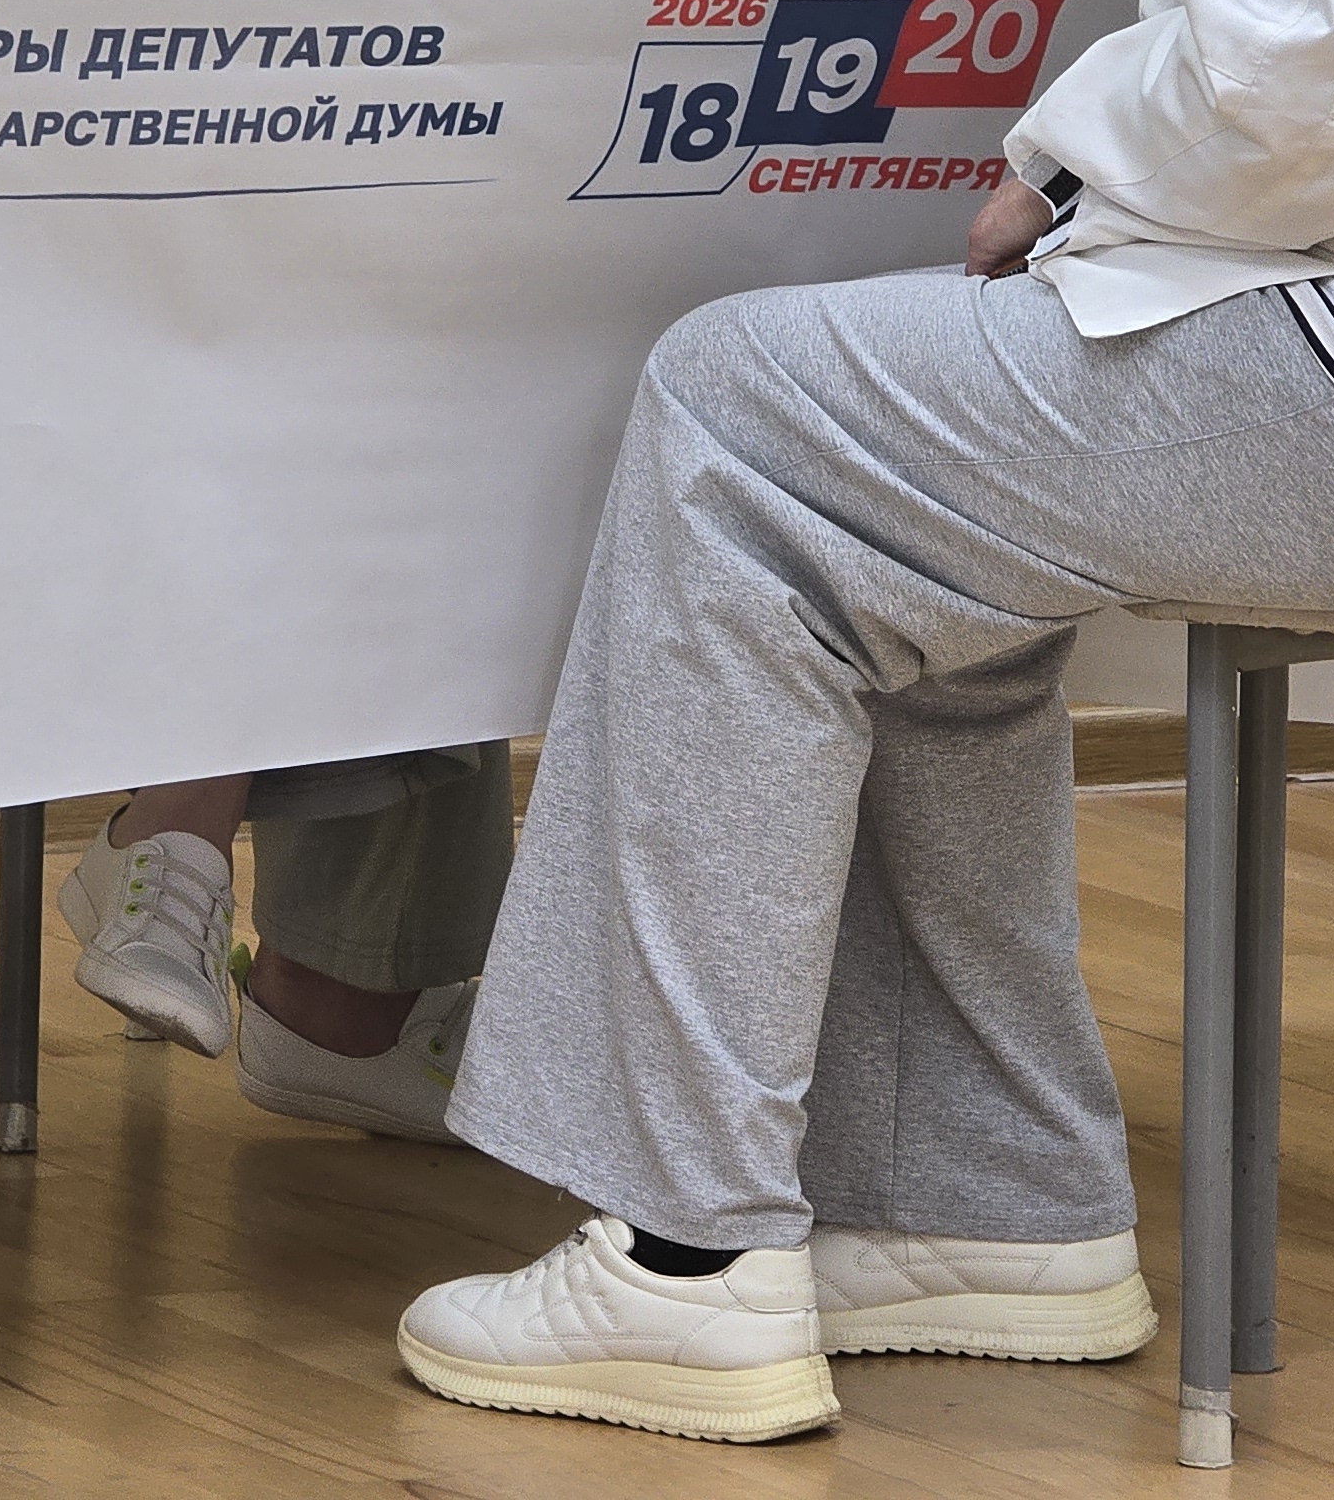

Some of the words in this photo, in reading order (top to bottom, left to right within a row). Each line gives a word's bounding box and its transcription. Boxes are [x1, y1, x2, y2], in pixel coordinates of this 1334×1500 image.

[78, 25, 445, 79] ДЕПУТАТОВ
[345, 101, 504, 145] ДУМЫ
[639, 82, 738, 163] 18
[776, 37, 878, 113] 19
[748, 157, 1008, 193] СЕНТЯБРЯ
